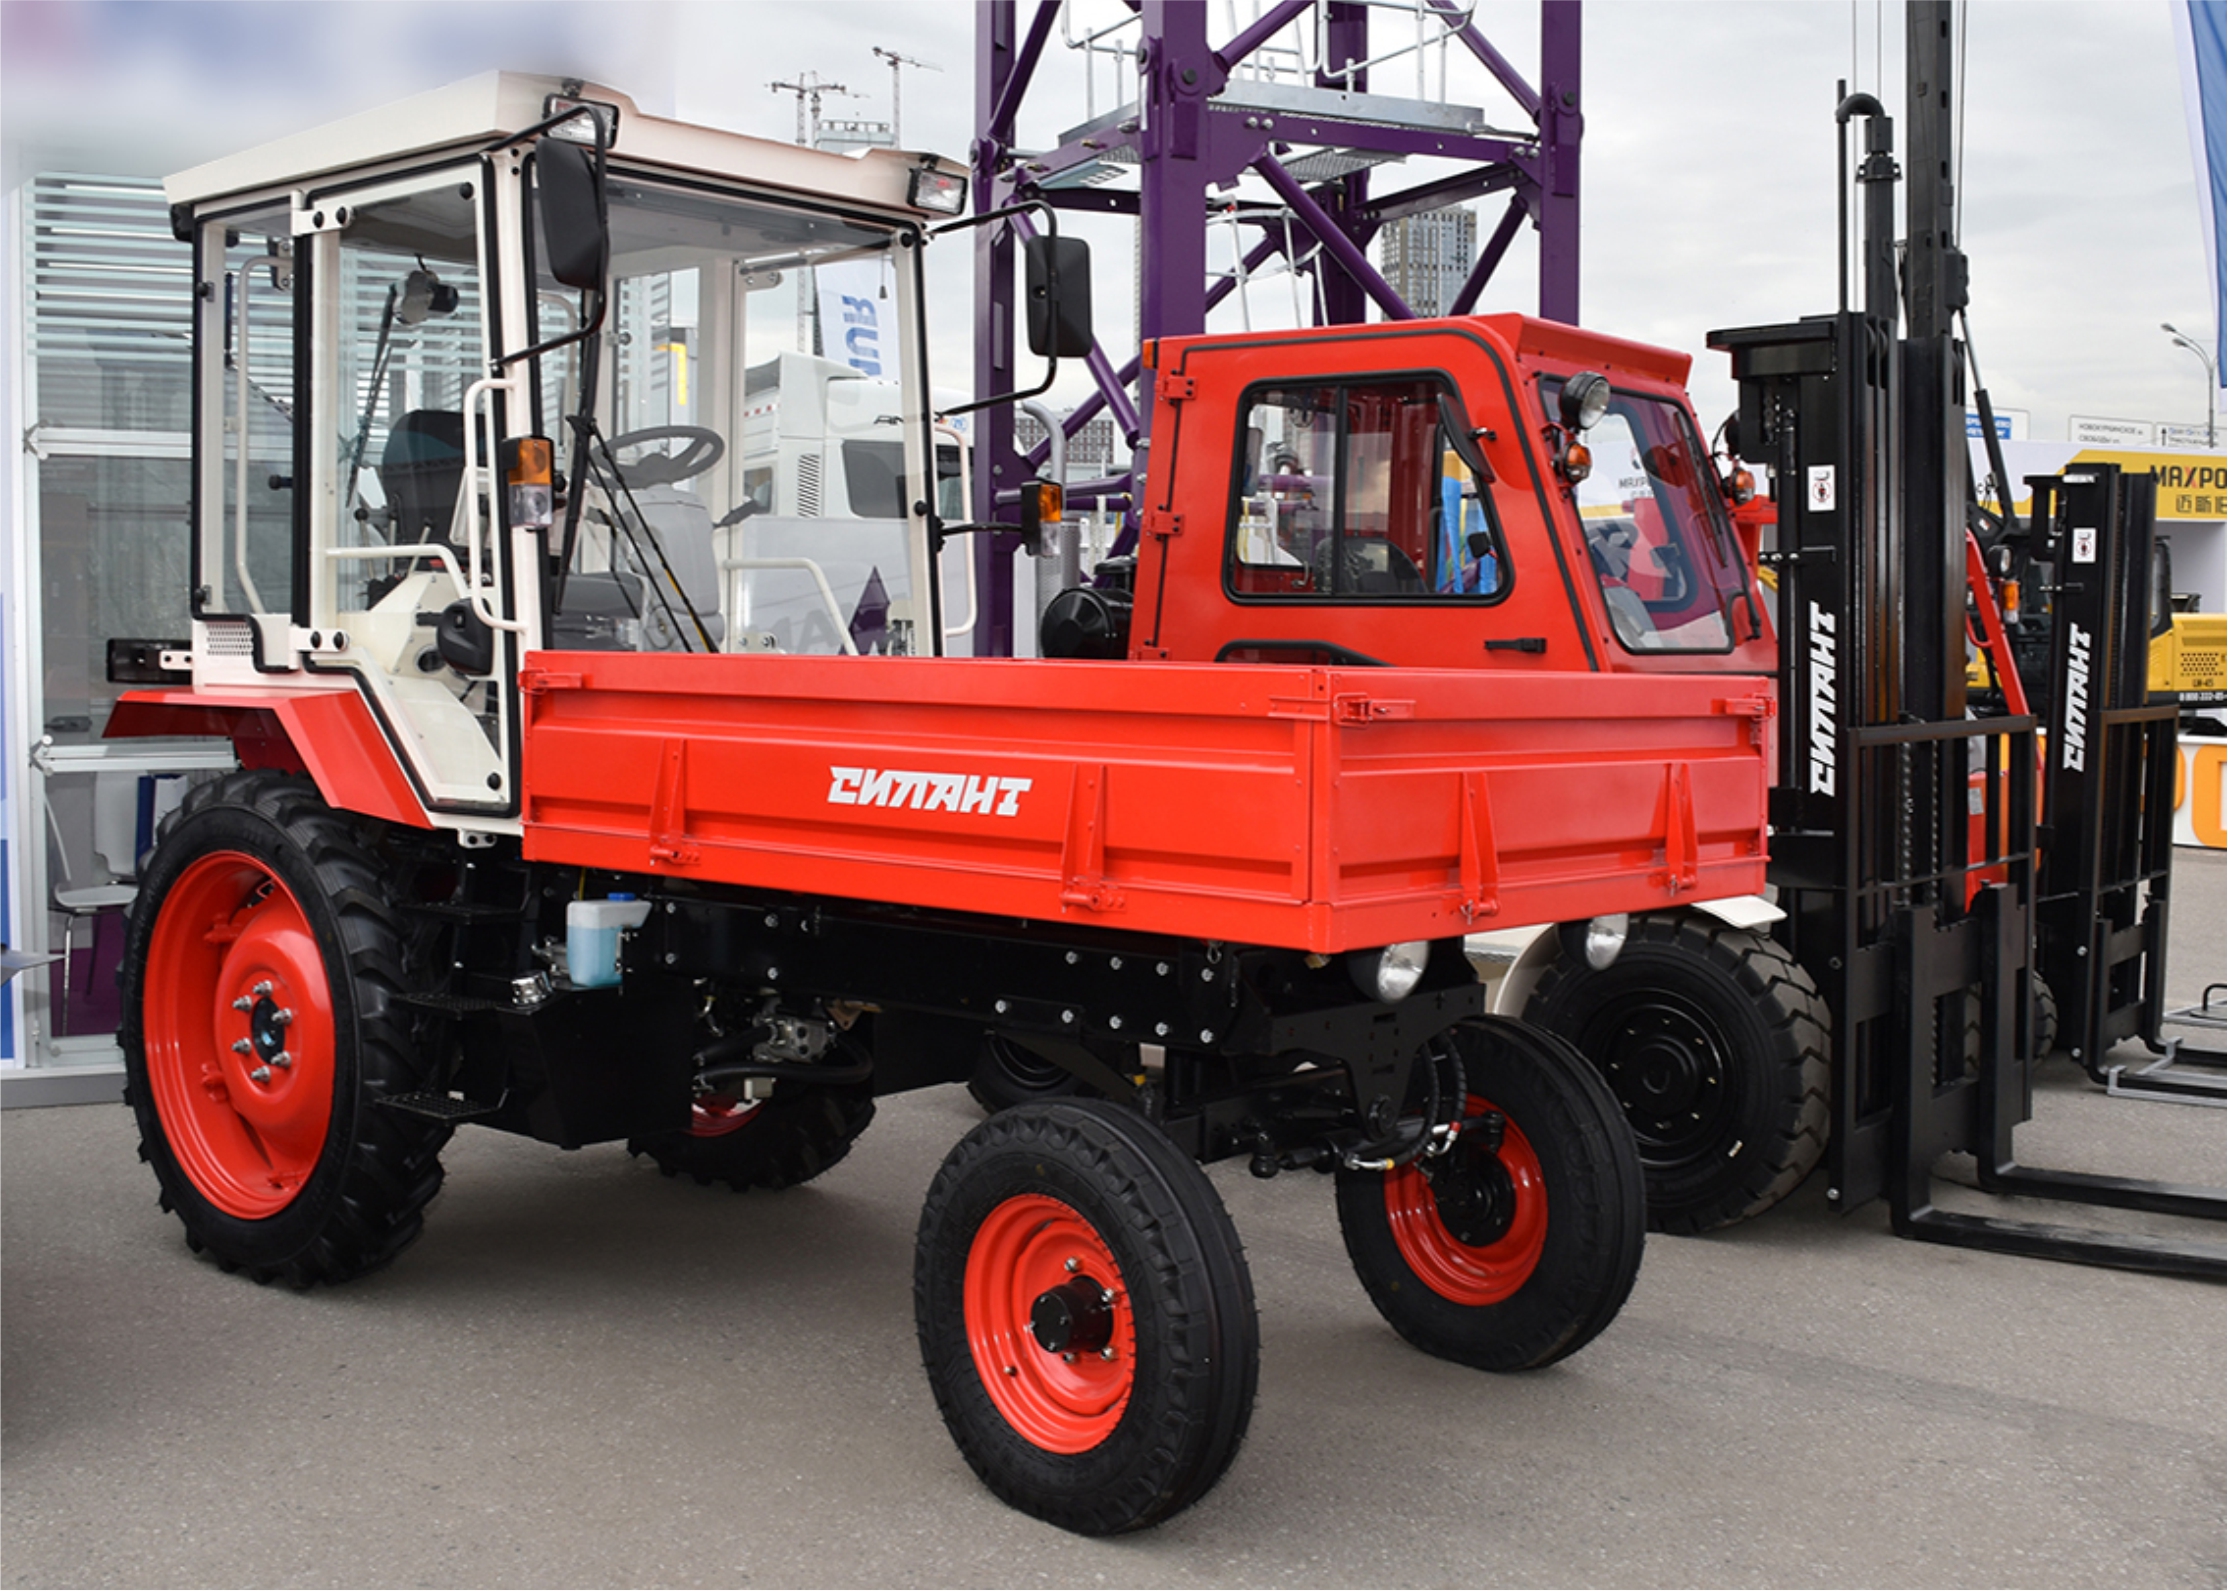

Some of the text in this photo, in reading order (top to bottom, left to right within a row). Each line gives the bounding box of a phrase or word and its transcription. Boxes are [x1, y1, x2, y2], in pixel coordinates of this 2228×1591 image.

[2150, 465, 2228, 489] MAXPO
[1810, 600, 1836, 797] СИЛАНТ
[2063, 622, 2092, 773] СИЛАНТ
[827, 765, 1034, 817] СИЛАНТ
